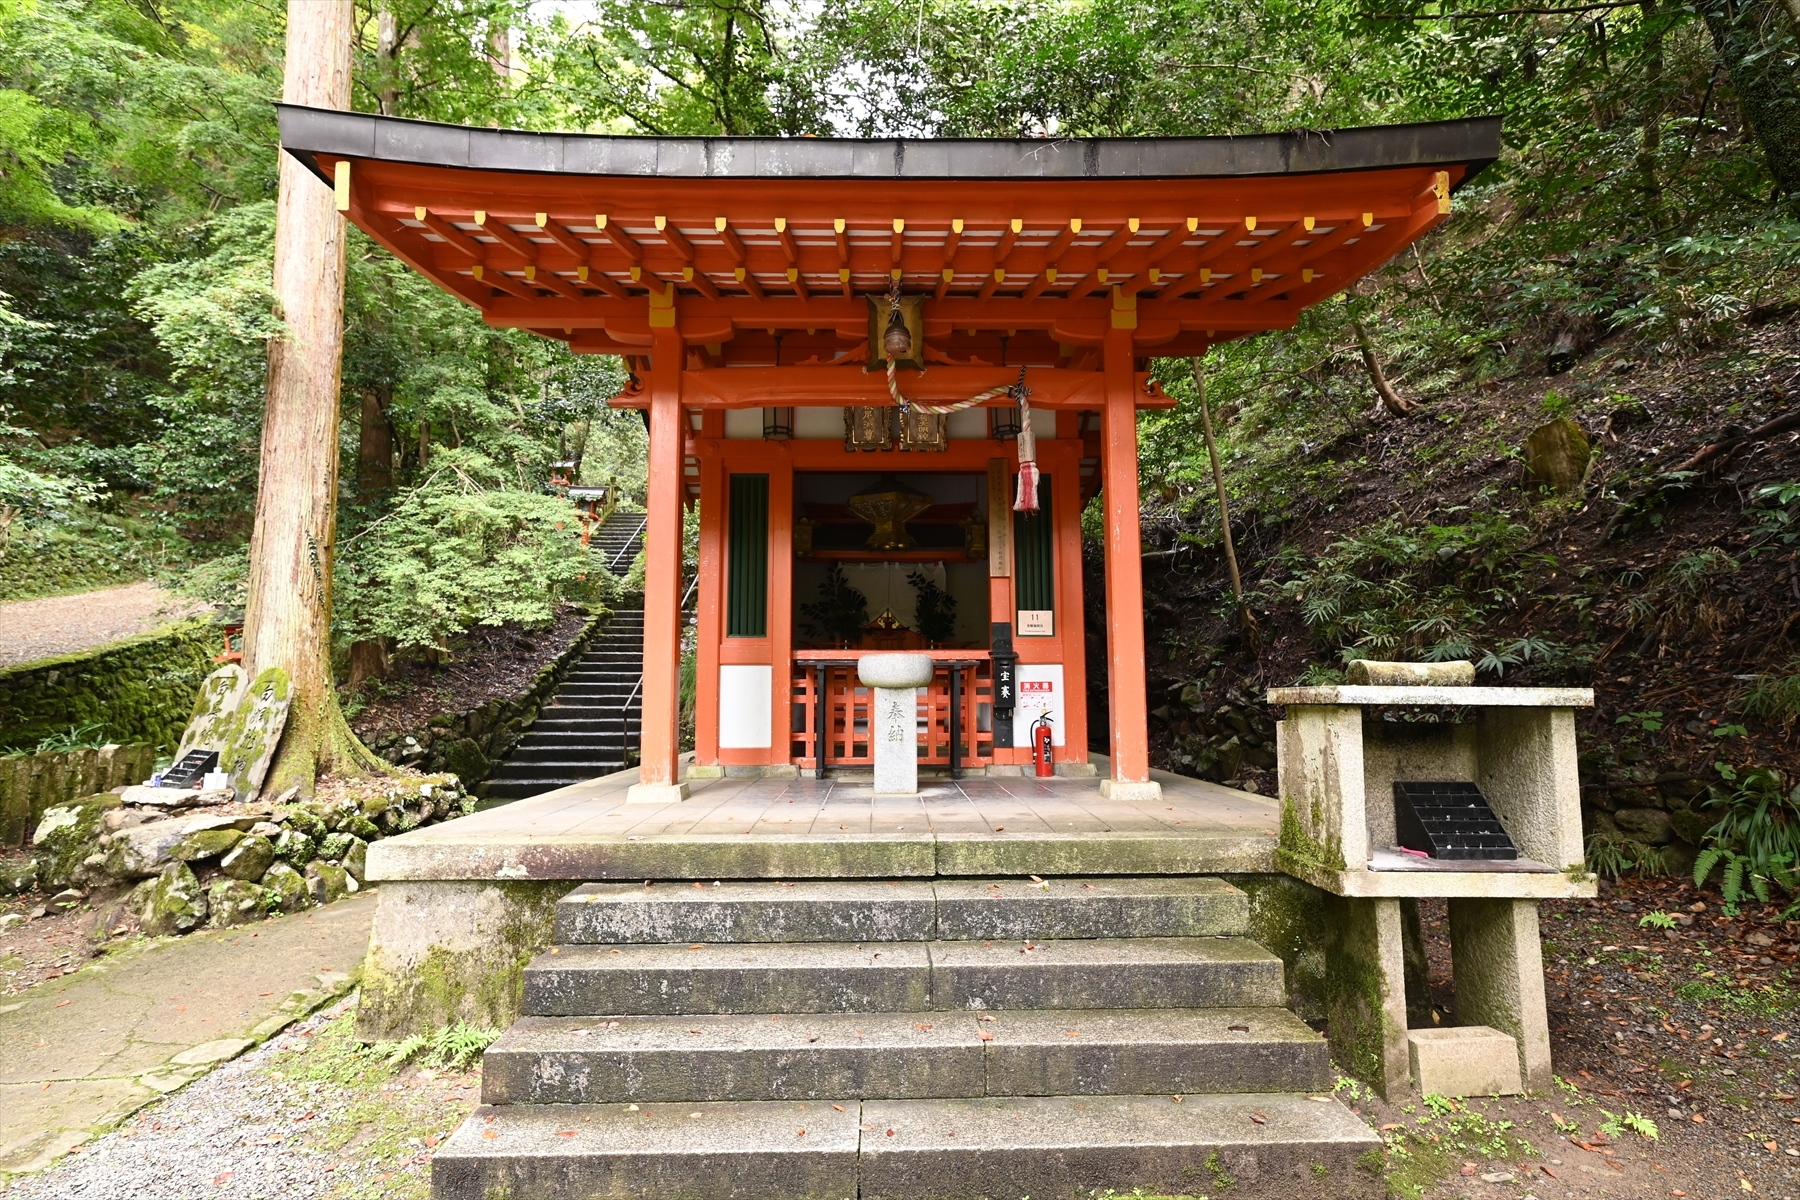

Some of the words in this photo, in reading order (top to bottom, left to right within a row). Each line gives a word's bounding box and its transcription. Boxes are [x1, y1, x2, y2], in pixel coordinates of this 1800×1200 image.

[1031, 613, 1039, 621] 11
[1023, 682, 1049, 690] 消火器
[887, 701, 905, 743] 奉納
